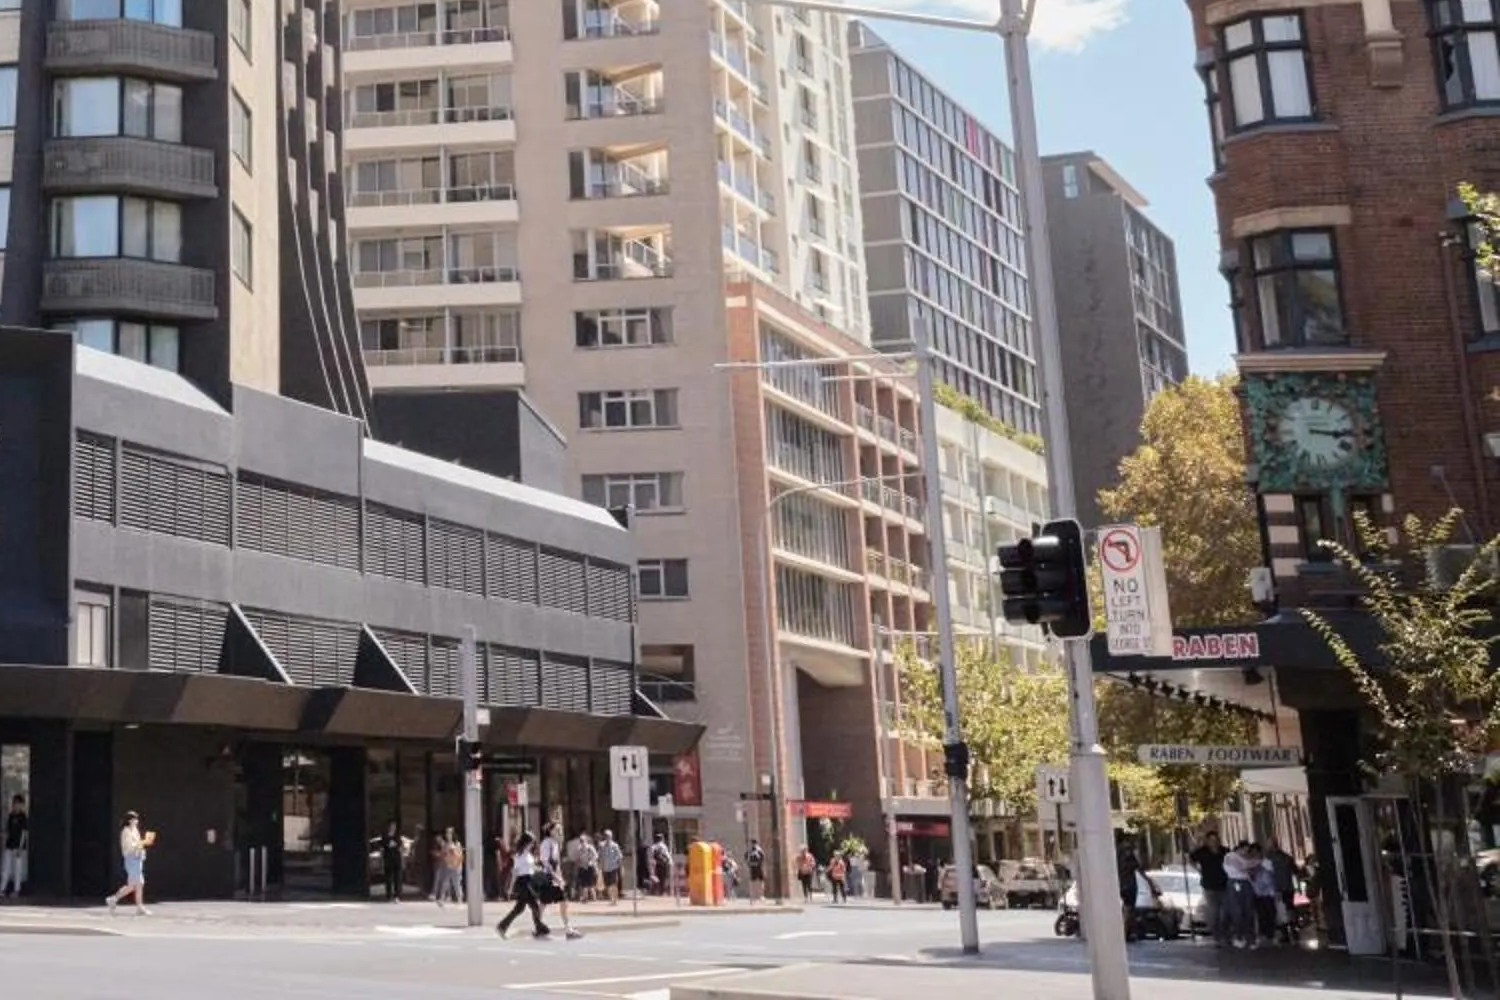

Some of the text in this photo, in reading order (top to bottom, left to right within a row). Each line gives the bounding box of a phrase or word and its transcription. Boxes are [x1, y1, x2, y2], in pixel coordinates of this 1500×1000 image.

[1113, 578, 1139, 593] NO
[1111, 595, 1141, 607] LEFT
[1112, 609, 1145, 621] TURN
[1172, 632, 1259, 660] RABEN
[1150, 747, 1291, 761] RABEN FOOTWEAR
